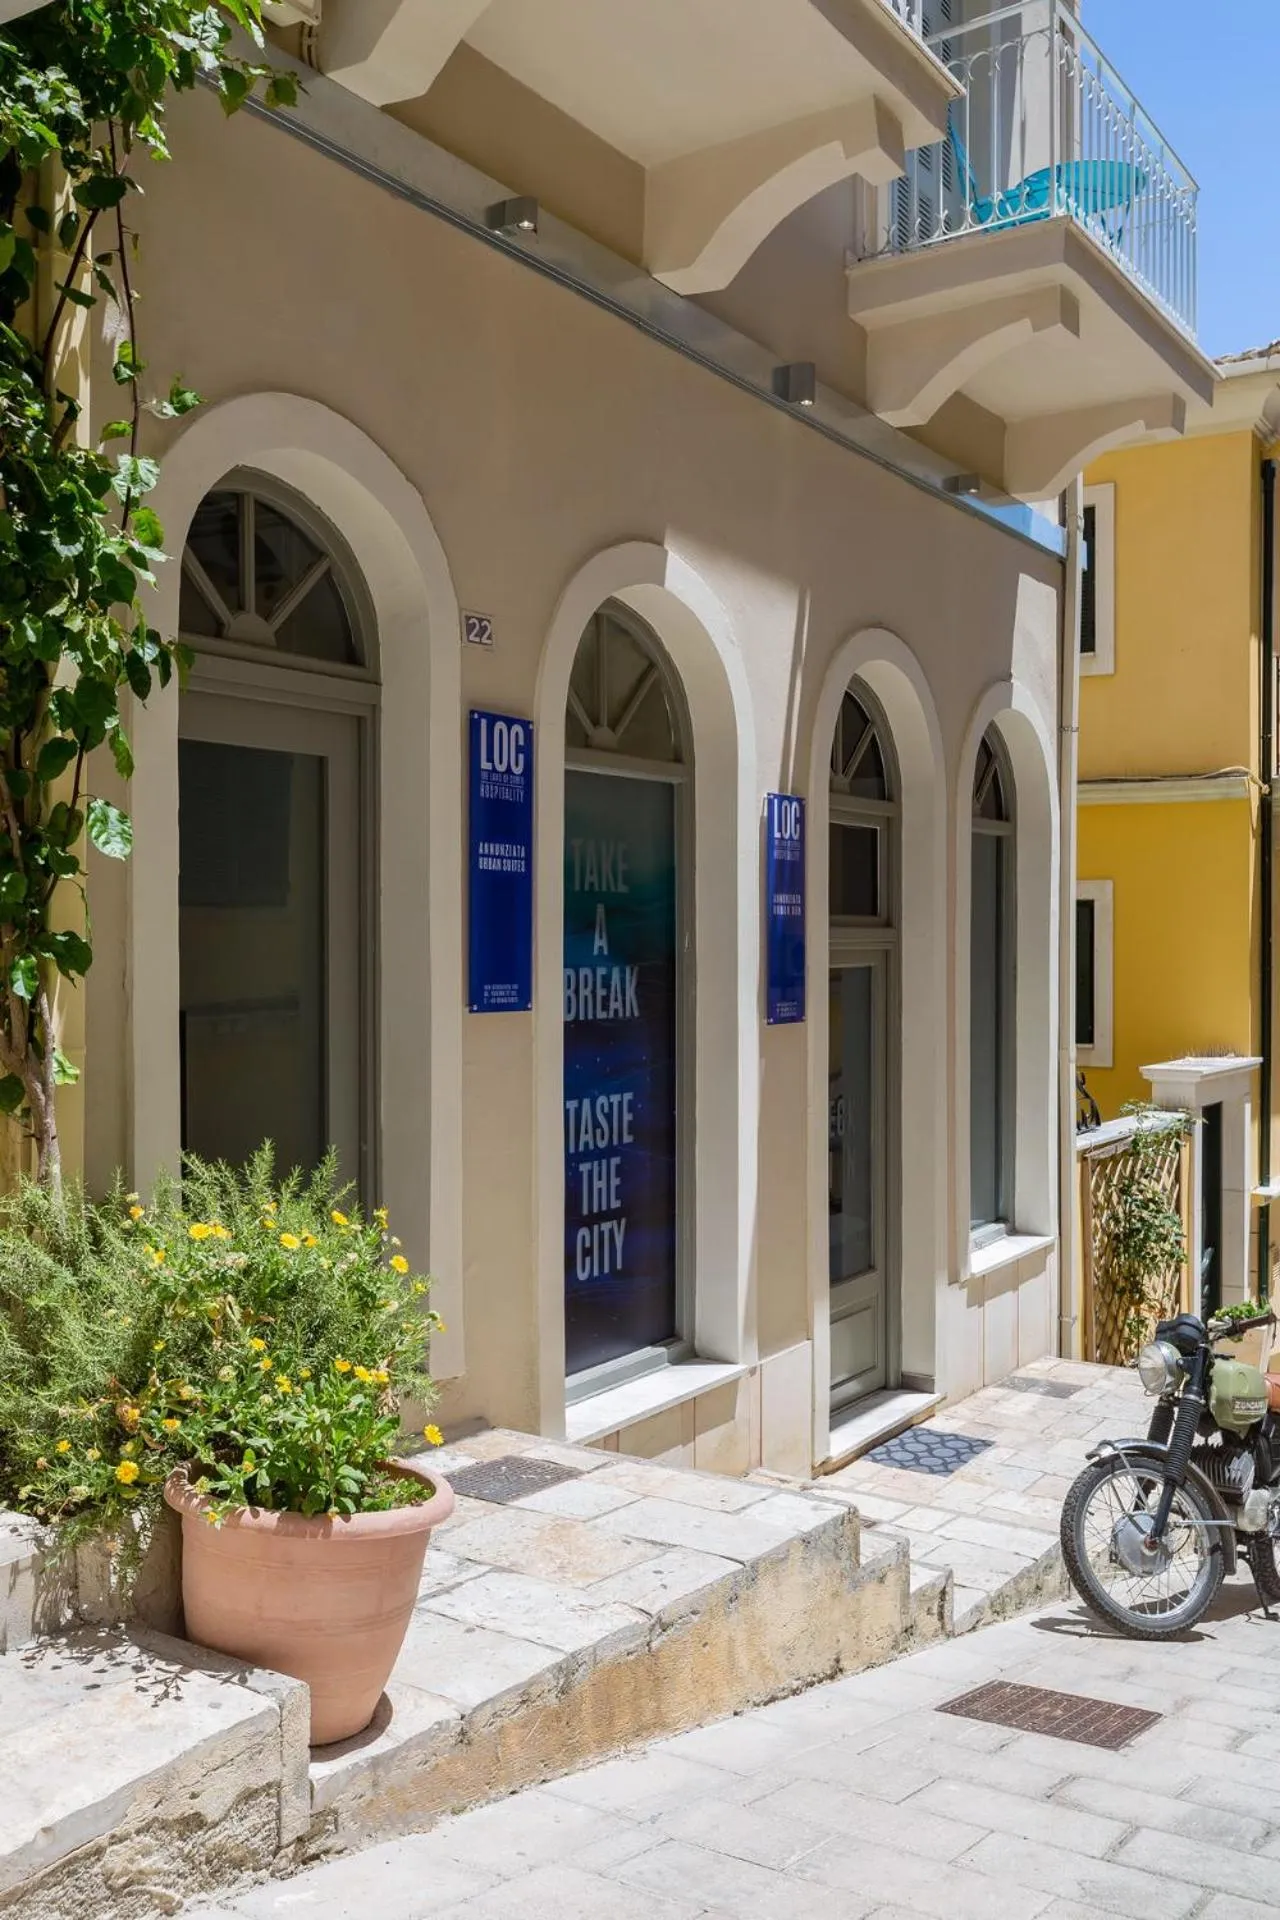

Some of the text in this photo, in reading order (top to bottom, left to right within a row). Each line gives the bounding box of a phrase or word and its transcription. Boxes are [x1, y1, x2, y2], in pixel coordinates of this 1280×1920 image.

[468, 617, 493, 644] 22
[480, 718, 525, 775] LOC
[479, 783, 525, 803] HOSPITALITY
[774, 798, 800, 840] LOC
[479, 841, 526, 858] ANNUNZIATA
[571, 838, 630, 893] TAKE
[593, 903, 609, 956] A
[563, 966, 640, 1022] BREAK
[565, 1092, 635, 1154] TASTE
[578, 1156, 622, 1216] THE
[576, 1217, 627, 1281] CITY
